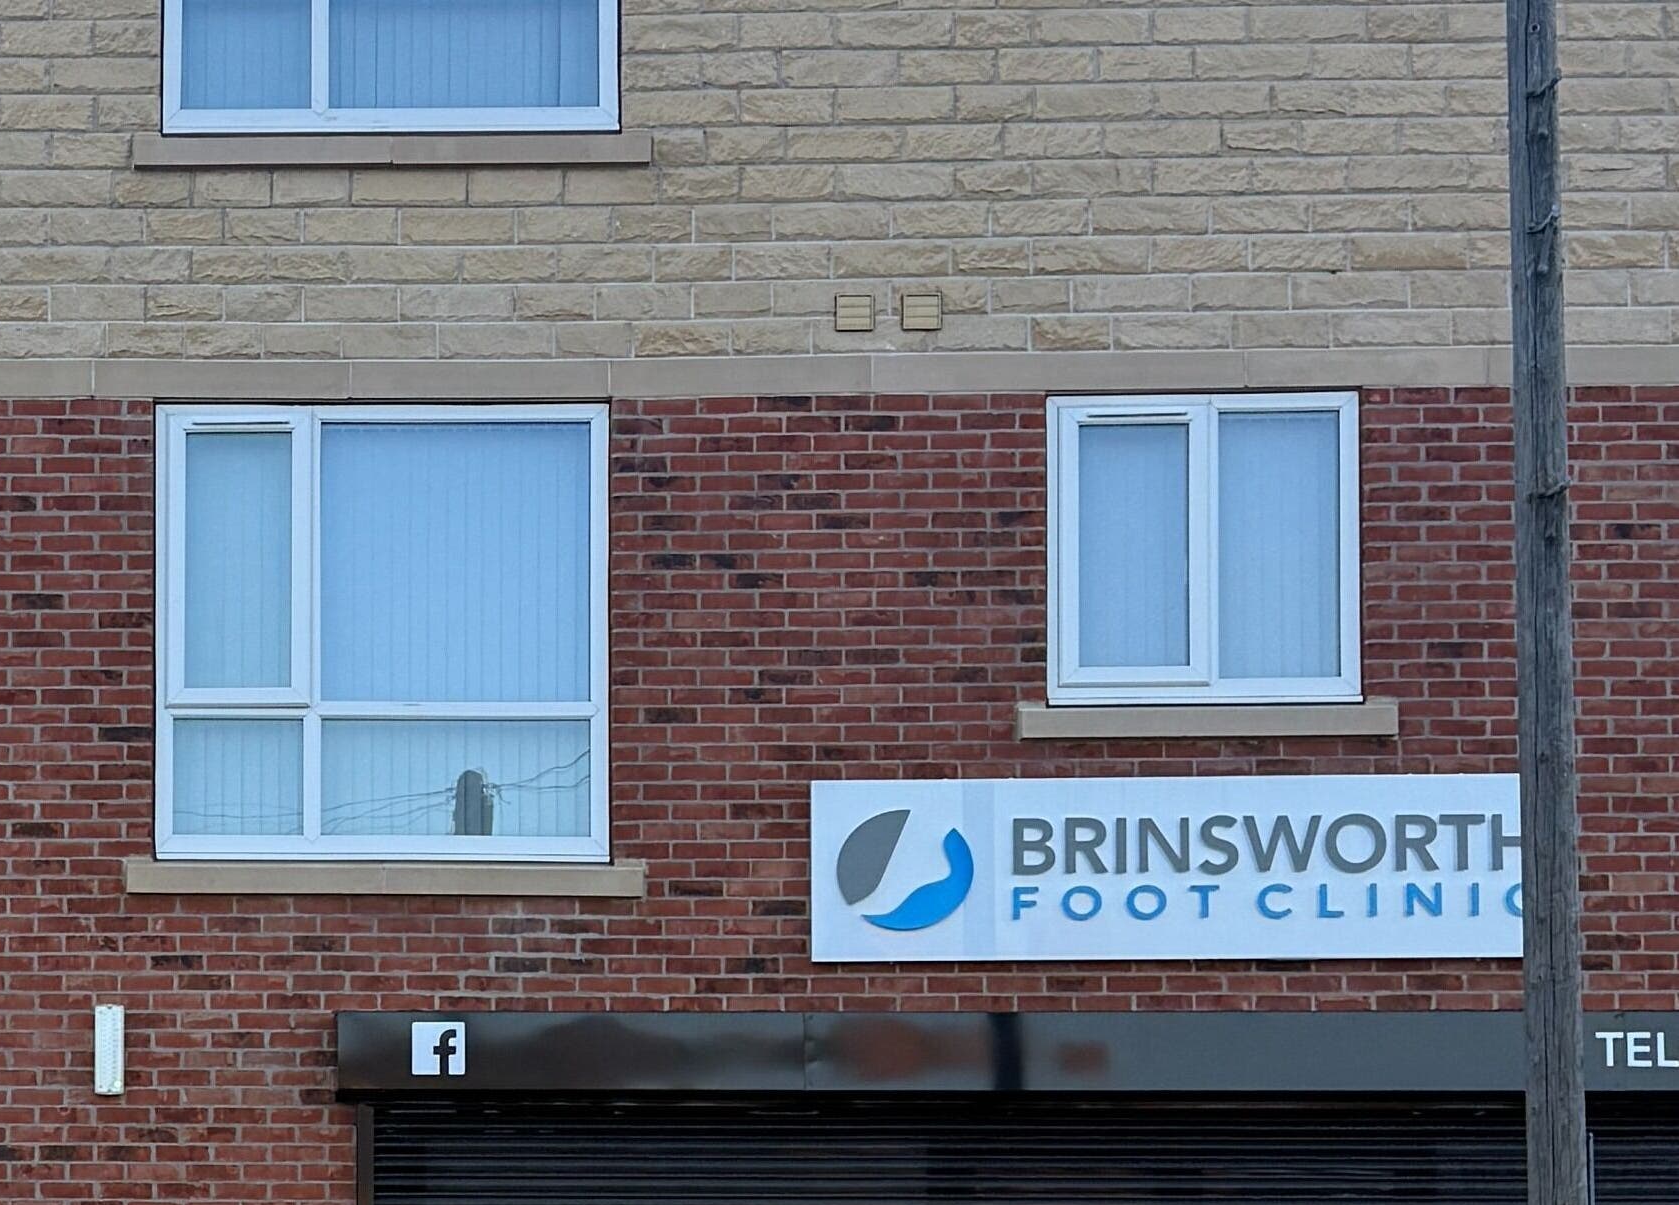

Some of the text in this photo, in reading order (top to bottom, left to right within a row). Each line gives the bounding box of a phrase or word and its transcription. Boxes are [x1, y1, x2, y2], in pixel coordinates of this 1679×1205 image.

[1011, 812, 1521, 876] BRINSWORTH
[1011, 884, 1220, 921] FOOT
[1595, 1031, 1679, 1067] TEL
